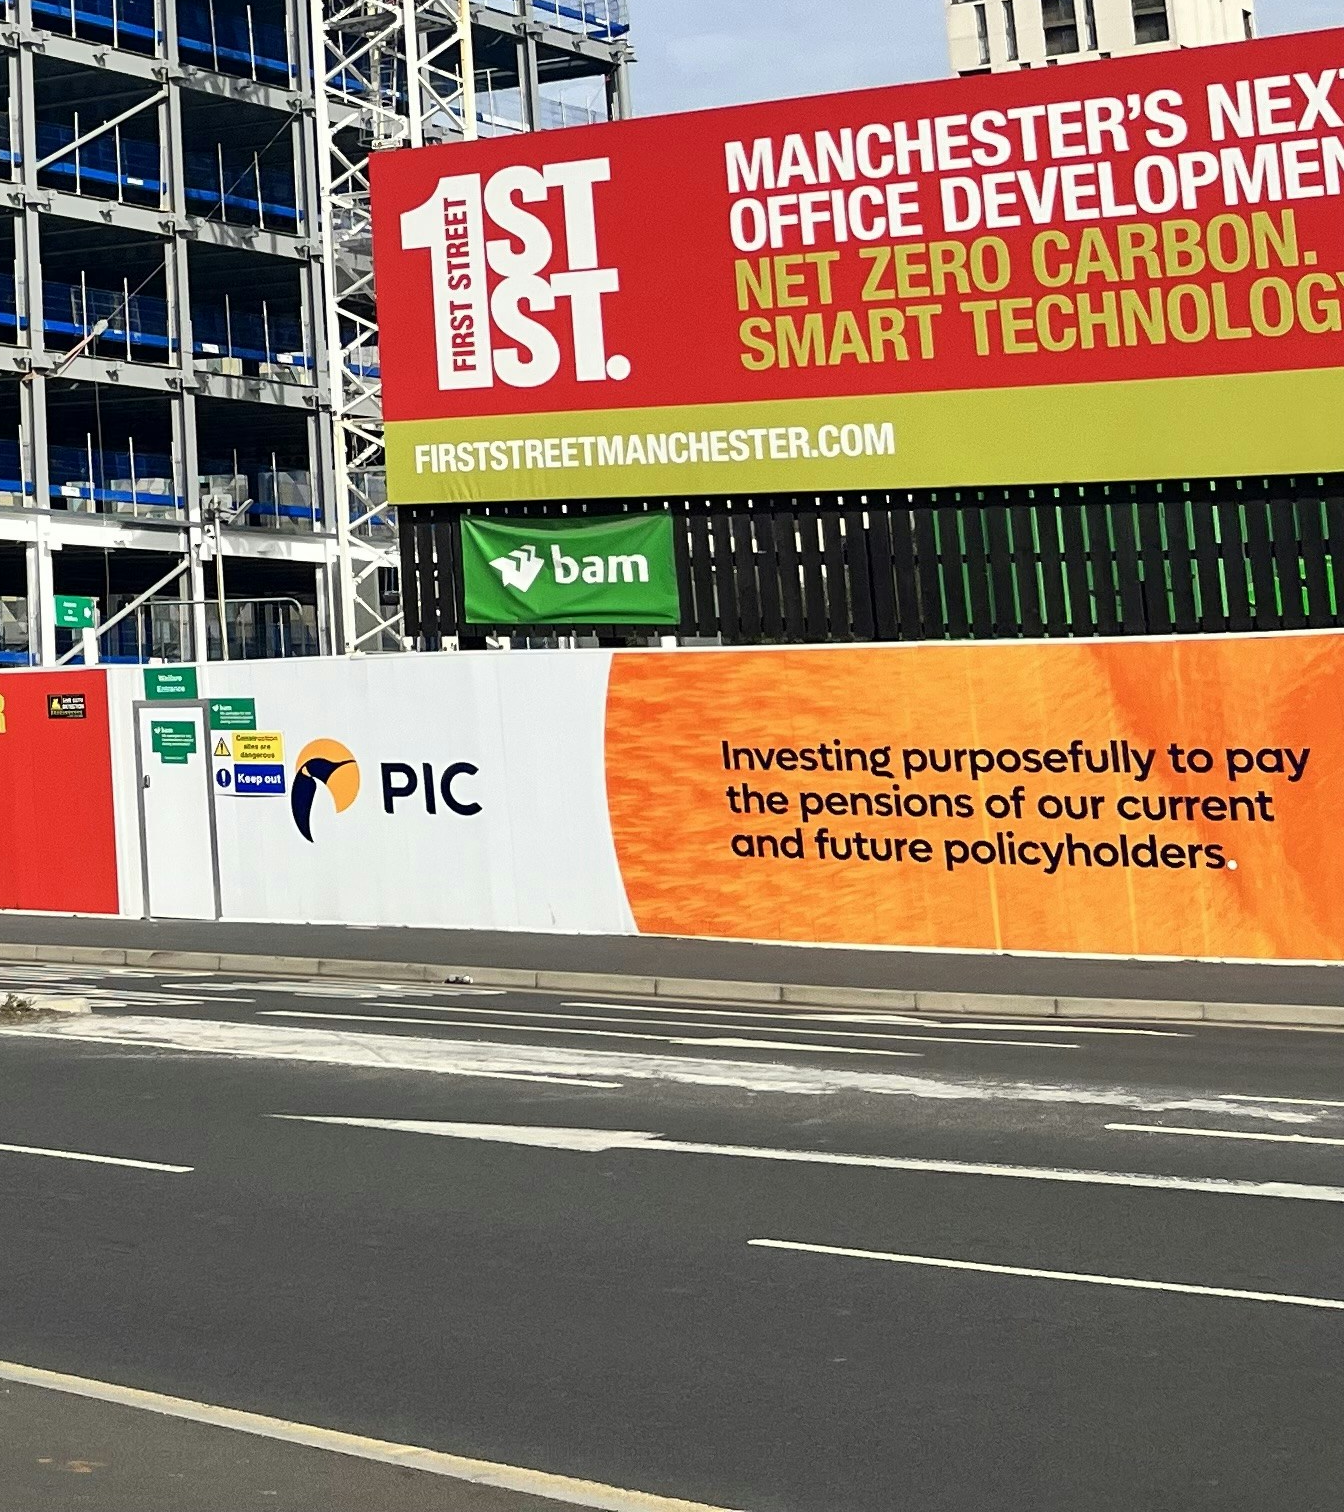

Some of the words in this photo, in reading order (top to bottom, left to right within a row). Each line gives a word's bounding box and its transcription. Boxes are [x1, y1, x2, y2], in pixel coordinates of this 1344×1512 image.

[724, 89, 1188, 193] MANCHESTER'S
[1206, 68, 1344, 141] NEX
[729, 181, 923, 252] OFFICE
[443, 197, 472, 291] STREET
[735, 251, 840, 311] NET
[859, 236, 1011, 301] ZERO
[1031, 208, 1318, 288] CARBON.
[450, 301, 477, 372] FIRST
[739, 304, 942, 371] SMART
[960, 270, 1344, 357] TECHNOLOG
[415, 422, 895, 474] FIRSTSTREETMANCHESTER.COM
[551, 544, 649, 585] bam
[156, 685, 186, 693] Entrance
[237, 772, 263, 786] Keep
[264, 773, 282, 784] out
[240, 751, 276, 759] dangerous
[721, 739, 894, 778] Investing
[903, 740, 1156, 781] purposefully
[1167, 743, 1214, 774] to
[1226, 747, 1311, 782] pay
[381, 762, 483, 816] PIC
[725, 782, 789, 814] the
[800, 784, 974, 823] pensions
[985, 785, 1026, 819] of
[1038, 794, 1105, 820] our
[1117, 790, 1275, 821] current
[731, 828, 805, 859] and
[815, 828, 933, 862] future
[944, 831, 1239, 875] policyholders.
